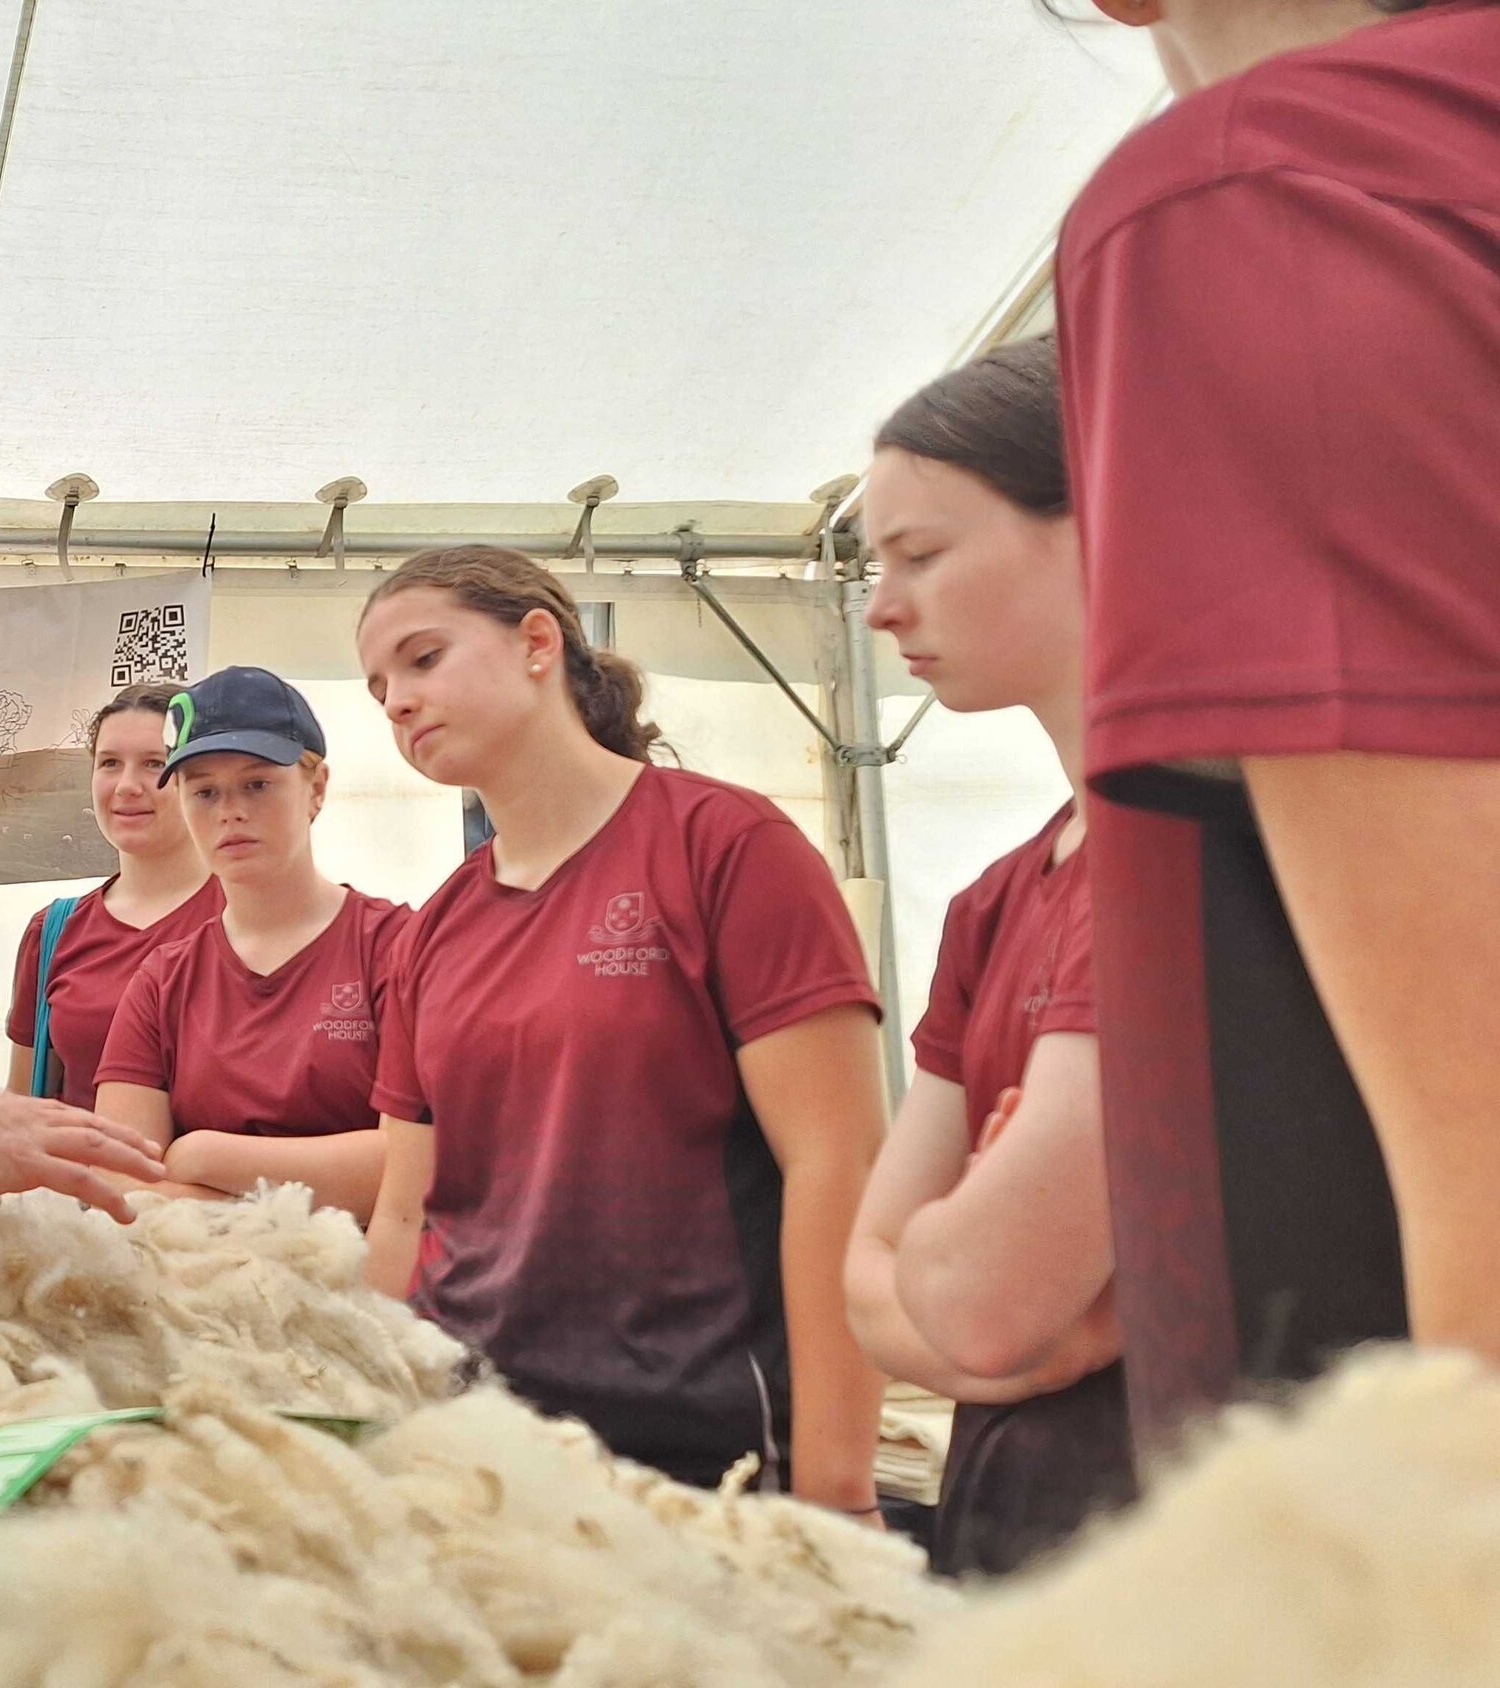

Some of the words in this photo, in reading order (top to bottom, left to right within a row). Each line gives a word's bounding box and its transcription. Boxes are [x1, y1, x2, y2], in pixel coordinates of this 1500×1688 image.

[576, 947, 670, 966] WOODFORD
[594, 961, 649, 977] HOUSE
[327, 1030, 369, 1041] HOUSE
